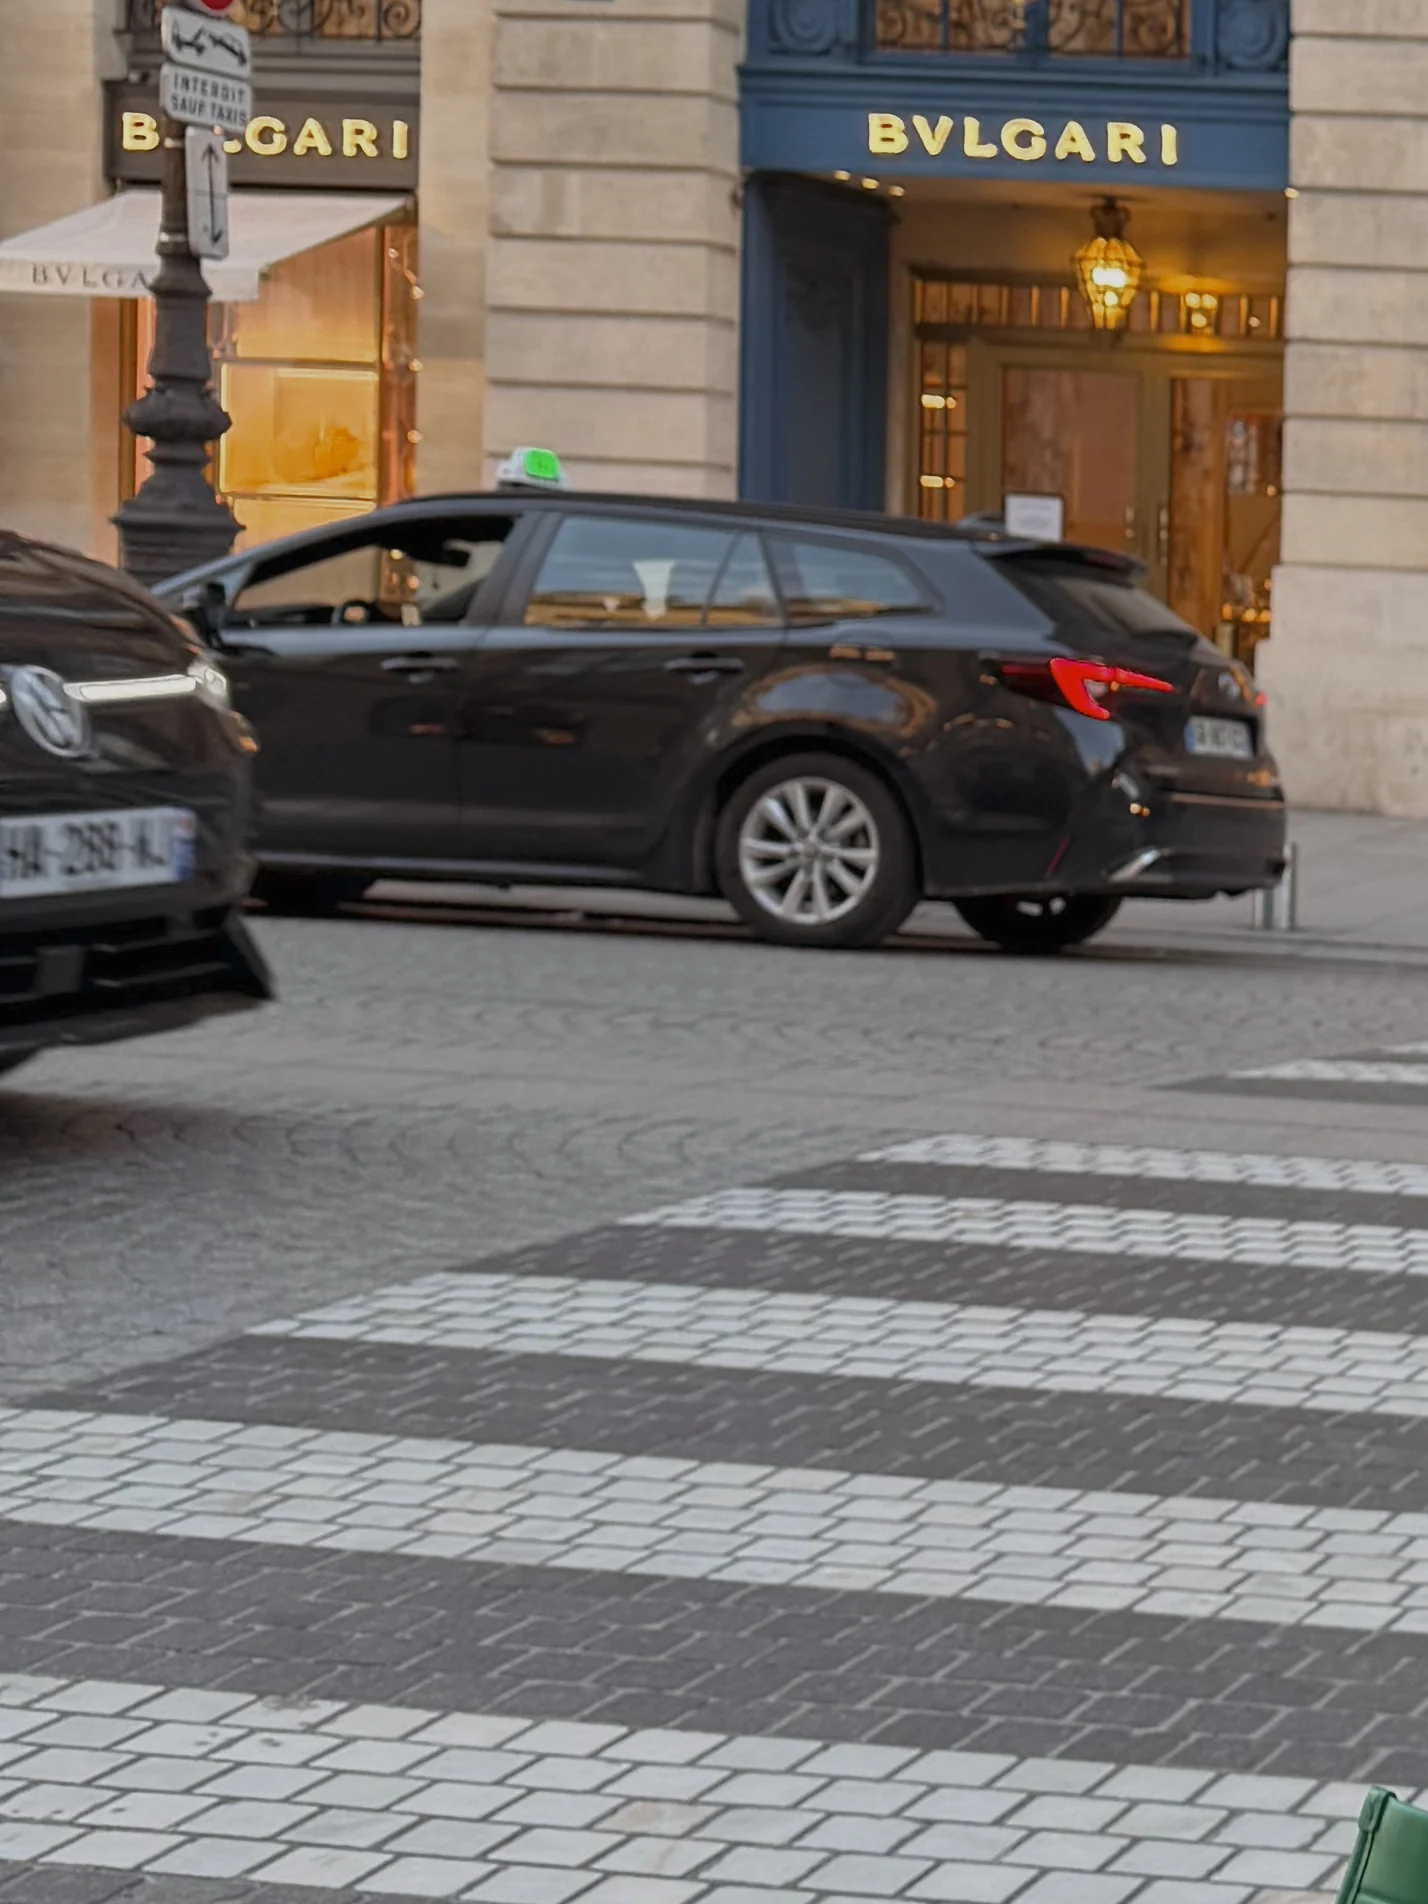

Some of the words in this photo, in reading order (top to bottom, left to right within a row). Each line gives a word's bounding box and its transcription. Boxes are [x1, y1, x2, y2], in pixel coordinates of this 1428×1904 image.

[173, 74, 245, 101] INTERDIT
[171, 92, 205, 116] SAUF
[210, 101, 248, 125] TAXIS
[122, 112, 408, 159] BGARI
[868, 112, 1178, 166] BVLGARI
[31, 263, 153, 291] BVLGA
